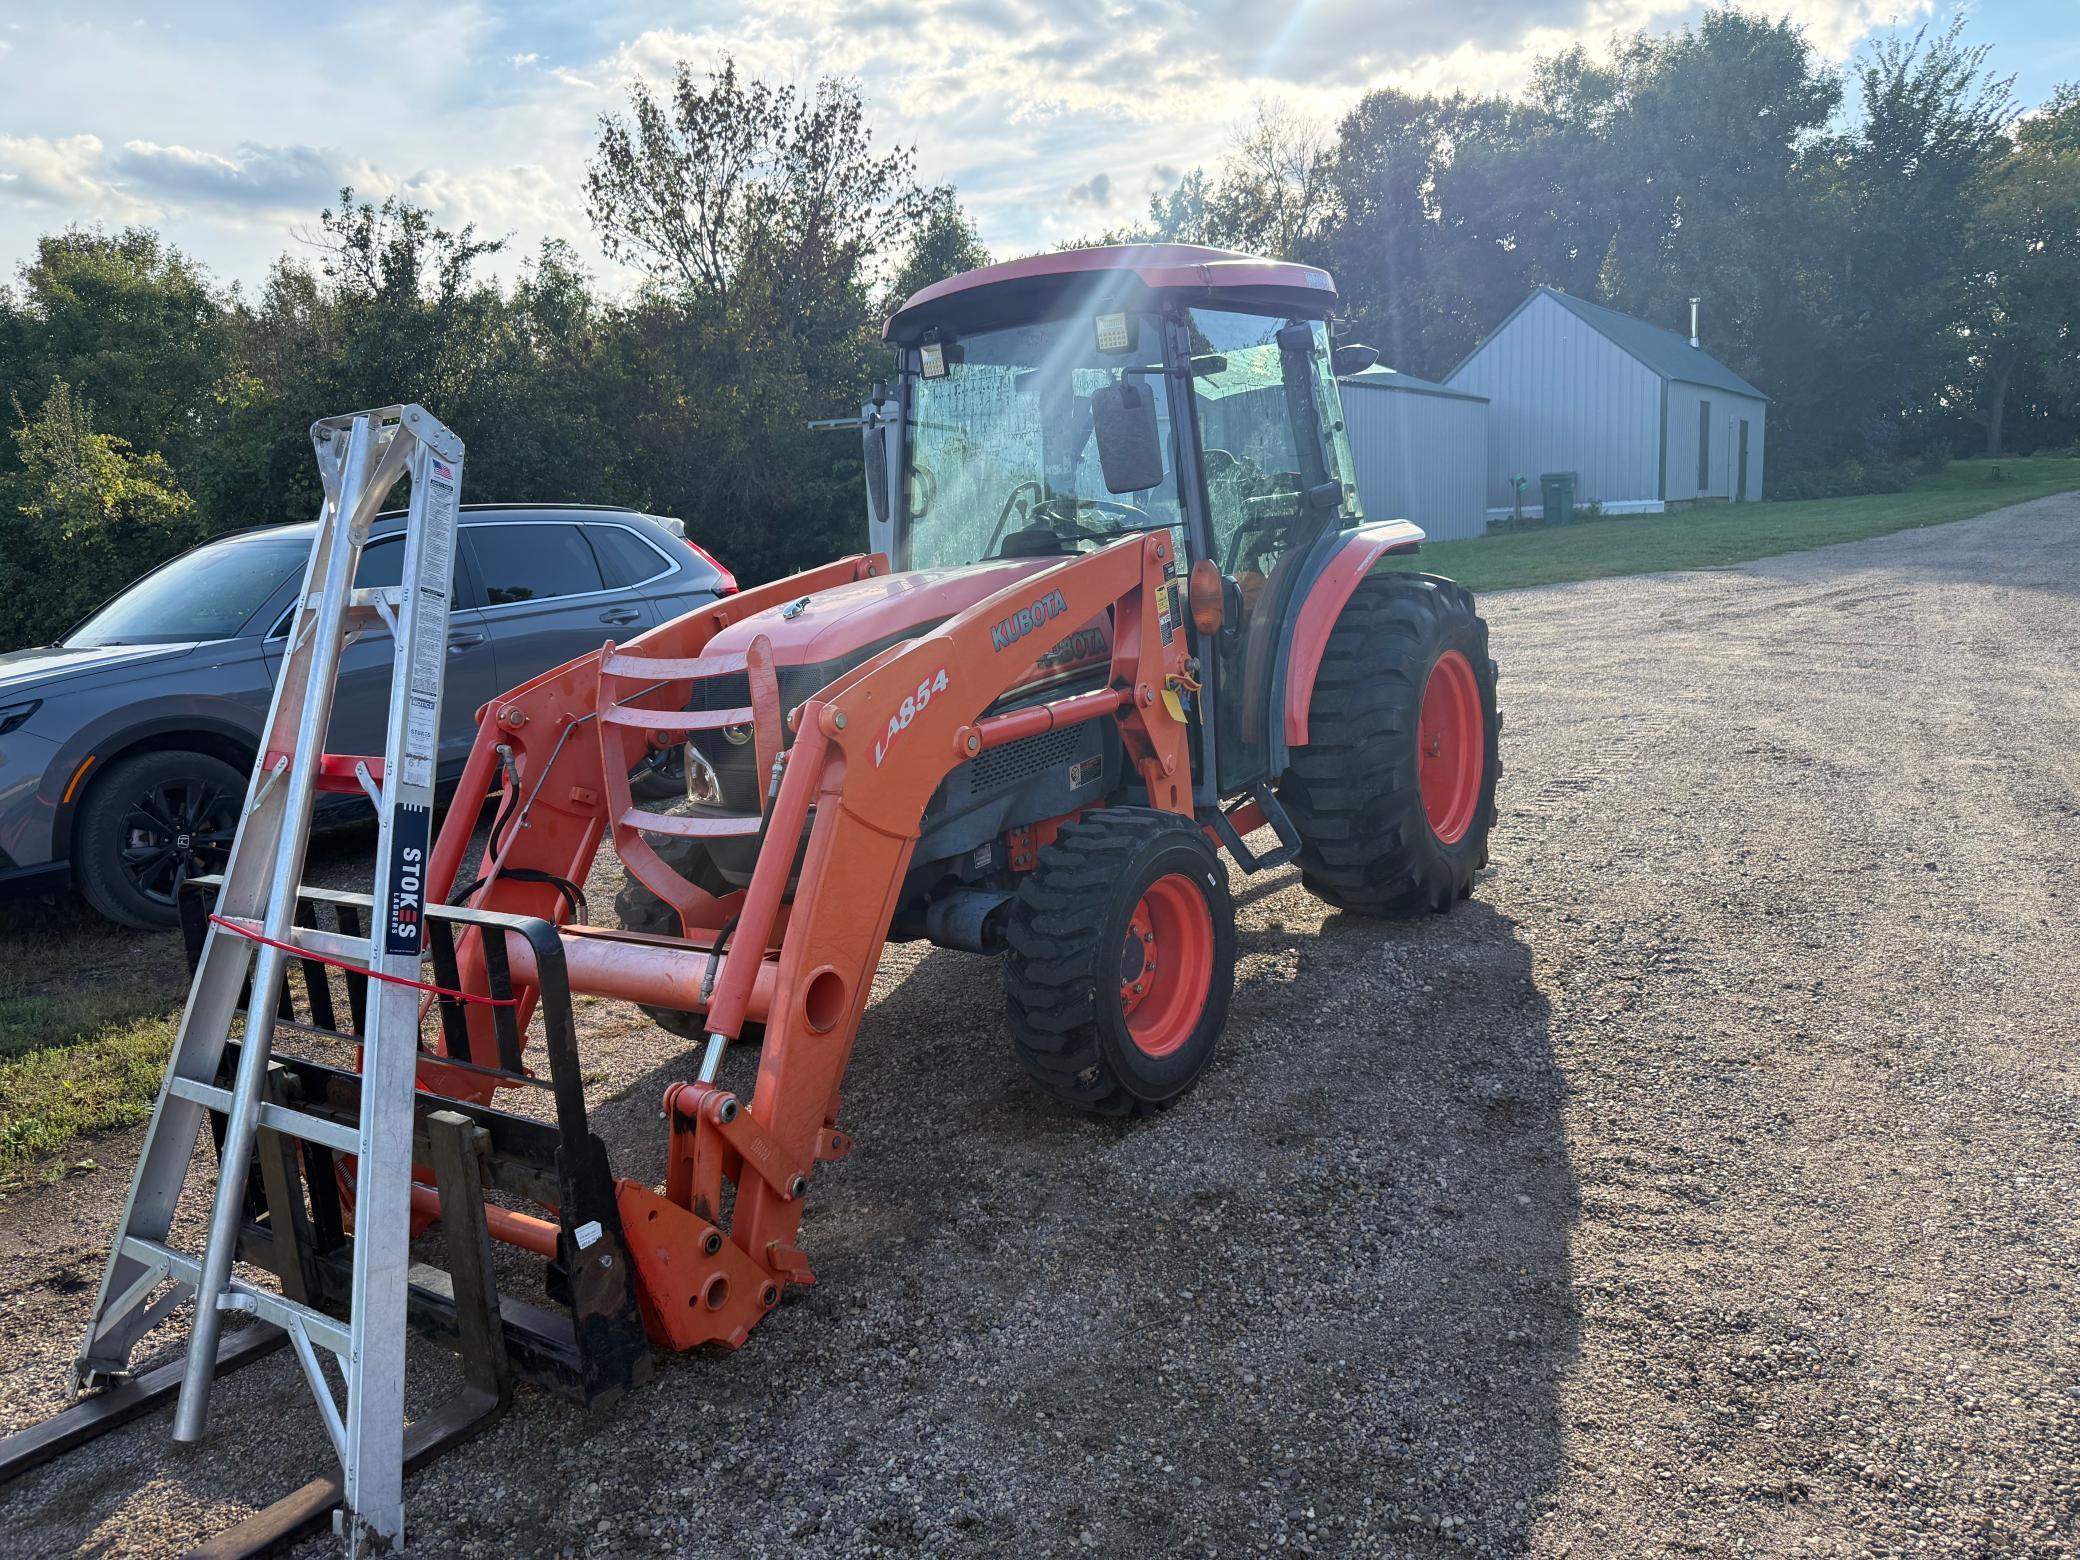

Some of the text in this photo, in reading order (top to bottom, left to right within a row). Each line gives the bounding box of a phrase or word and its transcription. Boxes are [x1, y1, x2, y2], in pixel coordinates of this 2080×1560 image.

[991, 588, 1068, 653] KUBOTA
[411, 699, 435, 710] NOTICE
[875, 669, 949, 768] LA854
[391, 892, 400, 935] LADDERS
[398, 847, 422, 938] STOKES
